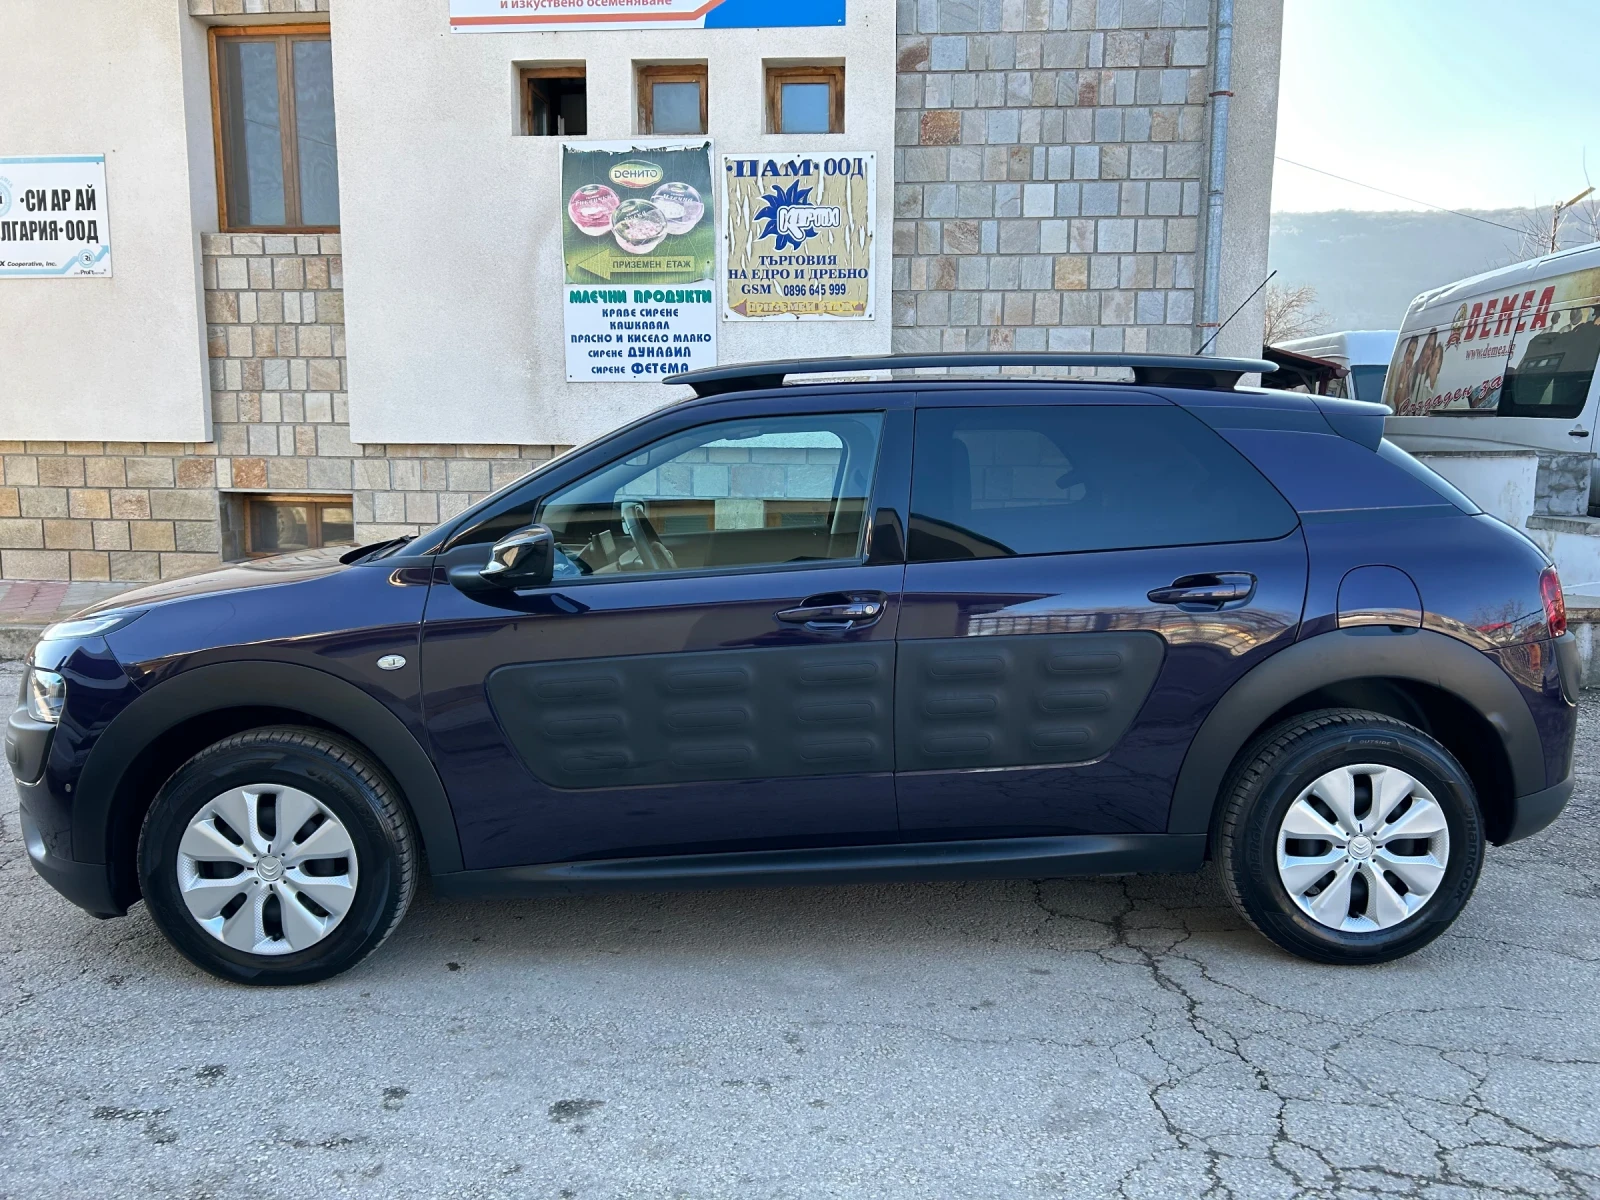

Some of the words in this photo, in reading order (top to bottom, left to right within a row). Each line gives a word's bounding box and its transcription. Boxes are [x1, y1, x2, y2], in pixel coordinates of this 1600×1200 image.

[500, 0, 508, 9] и
[511, 0, 584, 11] изкуствено
[824, 157, 864, 180] ООД
[51, 188, 71, 211] АР
[75, 184, 97, 211] АЙ
[7, 260, 44, 268] Cooperative,
[612, 260, 662, 269] ПРИЗЕМЕН
[666, 260, 691, 268] ЕТАЖ
[758, 255, 837, 266] ТЪРГОВИЯ
[728, 269, 749, 279] НА
[751, 269, 790, 281] ЕДРО
[793, 269, 805, 279] И
[808, 268, 869, 281] ДРЕБНО
[741, 284, 772, 294] GSM
[783, 284, 807, 297] 0896
[829, 283, 847, 295] 999
[569, 289, 627, 304] МЛЕЧНИ
[633, 289, 712, 304] ПРОДУКТИ
[602, 308, 637, 318] КРАВЕ
[640, 308, 679, 317] СИРЕНЕ
[609, 321, 670, 330] КАШКАВАЛ
[570, 334, 612, 343] ПРЯСНО
[616, 334, 623, 343] И
[627, 334, 669, 343] КИСЕЛО
[673, 333, 712, 343] МЛЯКО
[588, 350, 623, 358] СИРЕНЕ
[591, 366, 626, 374] СИРЕНЕ
[631, 362, 689, 374] ФЕТЕМА
